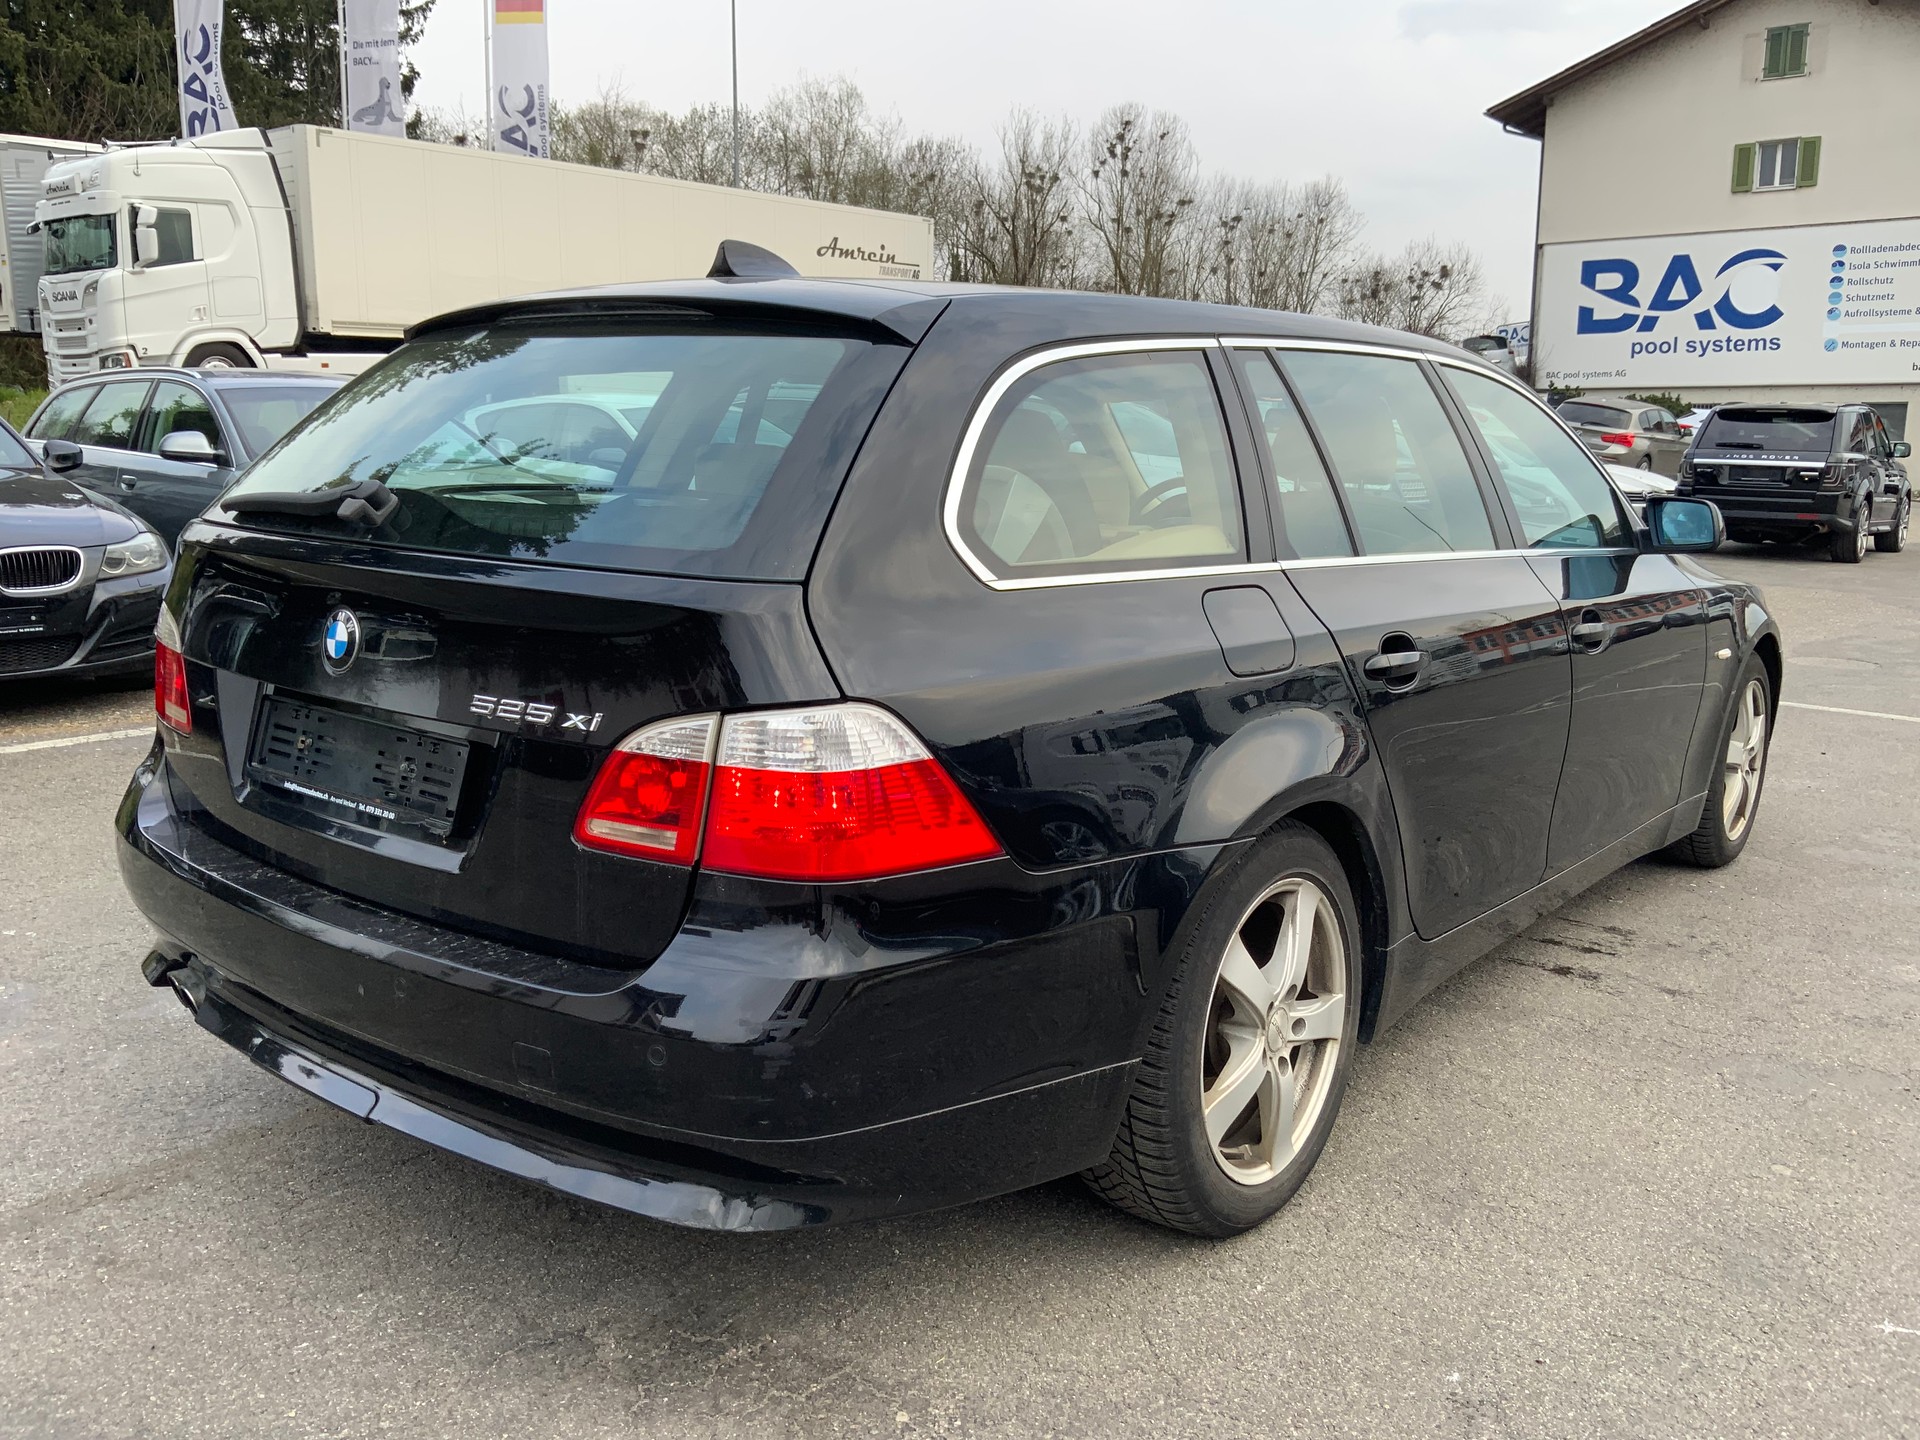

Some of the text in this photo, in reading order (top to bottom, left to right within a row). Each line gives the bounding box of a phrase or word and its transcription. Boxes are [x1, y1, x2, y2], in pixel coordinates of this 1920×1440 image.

[352, 38, 396, 50] Die mit dem
[183, 22, 221, 138] BAC
[212, 82, 228, 110] pool
[498, 83, 539, 157] AC
[537, 83, 550, 159] pool systems
[816, 236, 920, 268] Amrein
[878, 265, 921, 280] TRANSPORT AG
[1848, 262, 1871, 271] Isola
[1847, 277, 1894, 287] Rollschutz
[51, 290, 79, 302] SCANIA
[1576, 248, 1789, 335] BAC
[1845, 293, 1895, 303] Schutznetz
[1844, 307, 1912, 318] Aufrollsysteme
[141, 347, 149, 355] 2
[1630, 335, 1782, 359] pool systems
[1841, 341, 1887, 350] Montagen
[1889, 340, 1897, 348] &
[1545, 369, 1627, 380] BAC pool systems AG
[469, 694, 556, 726] 525
